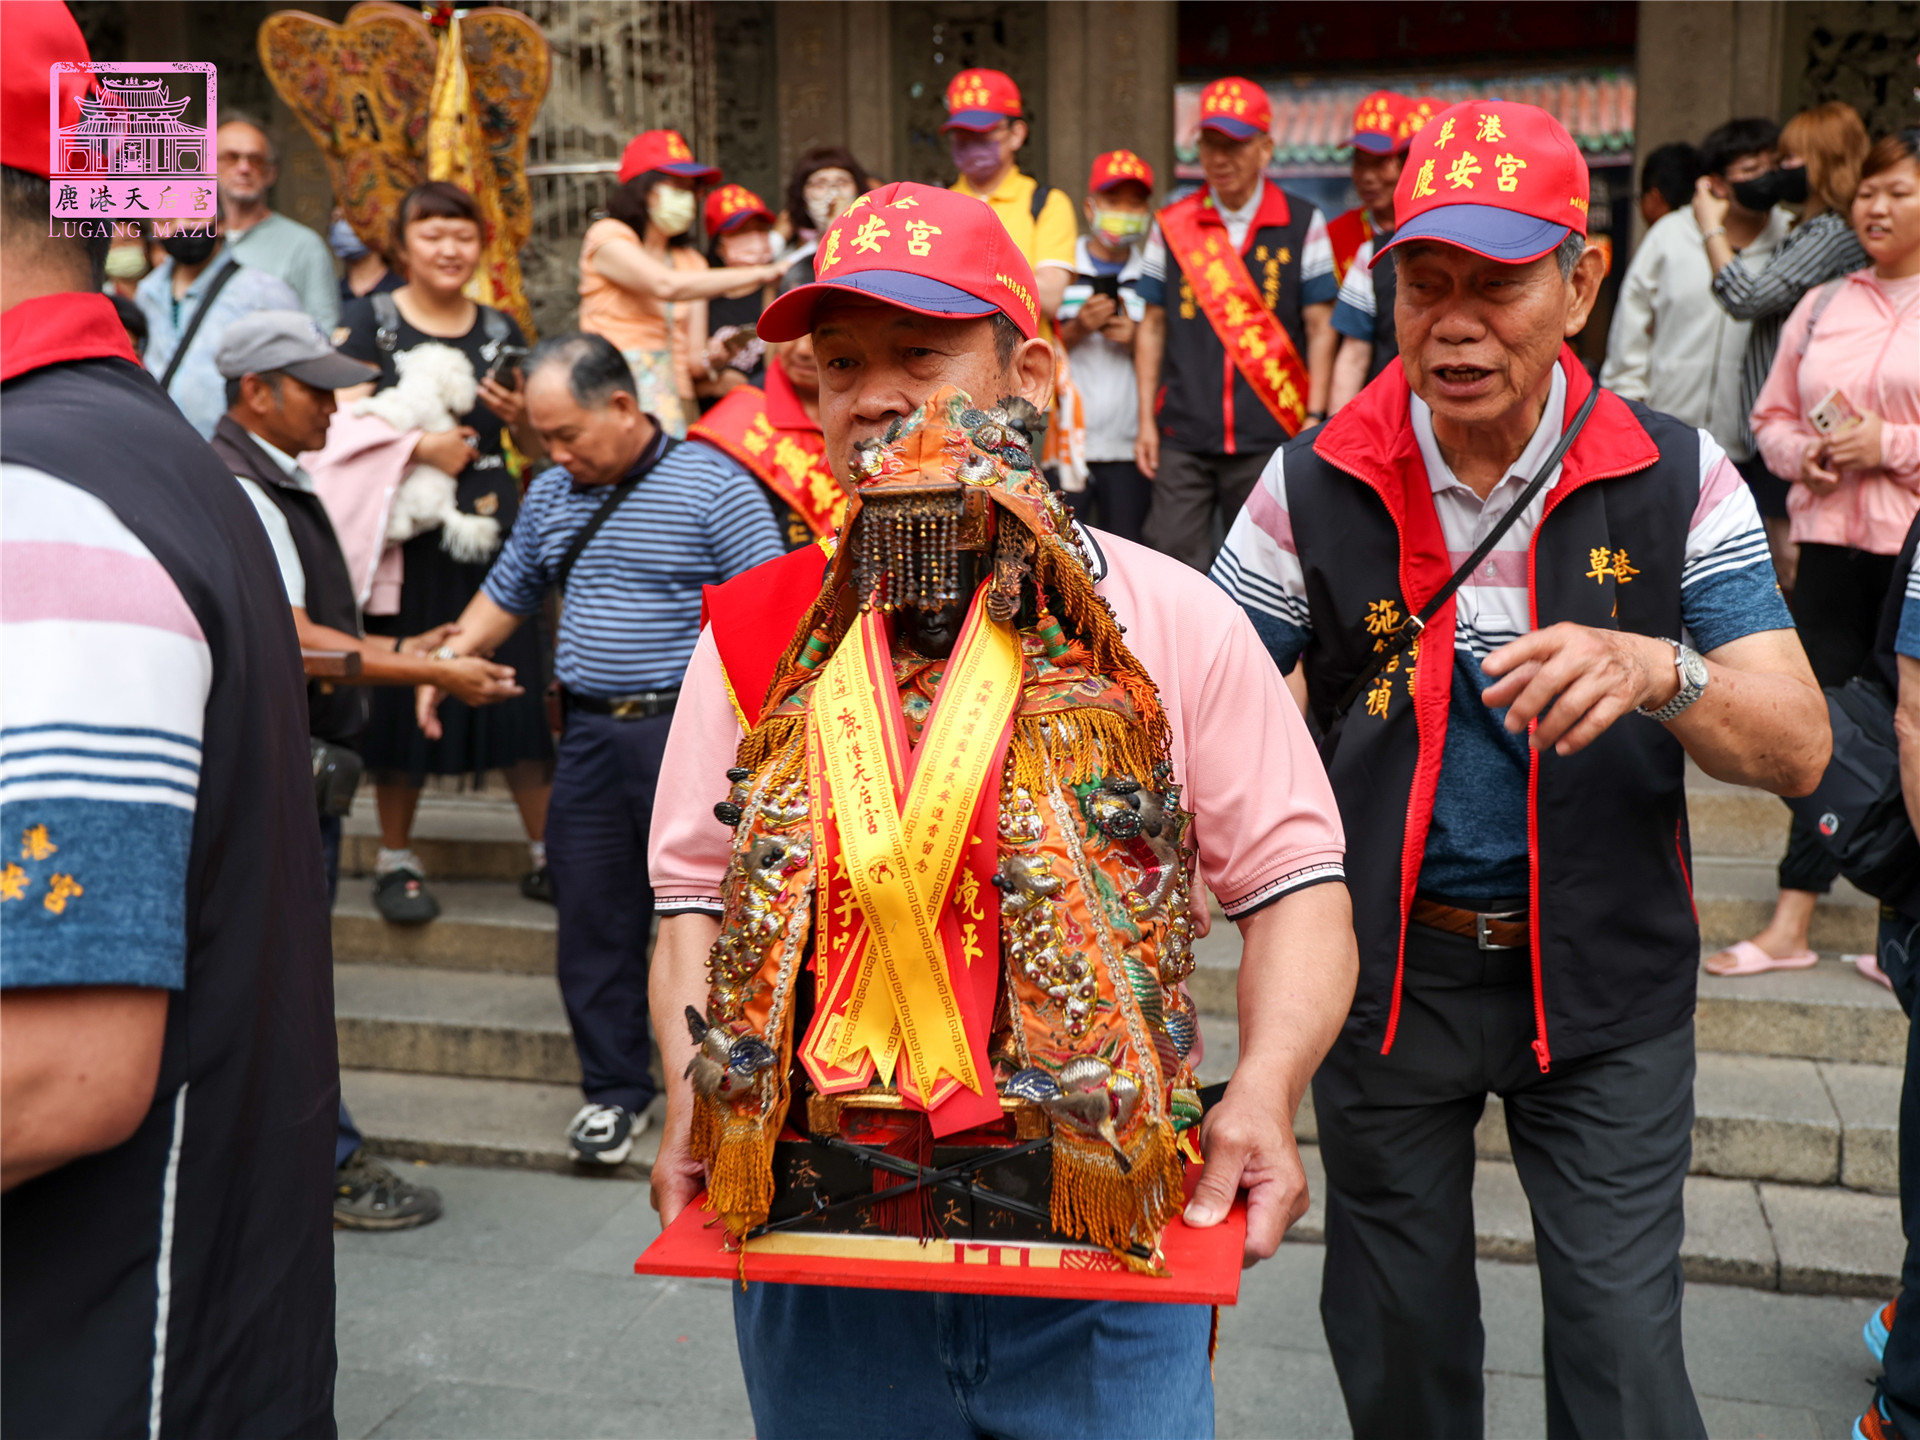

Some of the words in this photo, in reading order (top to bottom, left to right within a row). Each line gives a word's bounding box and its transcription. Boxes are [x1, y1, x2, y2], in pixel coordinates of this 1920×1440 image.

[1434, 114, 1506, 150] 草港
[1411, 151, 1527, 200] 慶安宮
[820, 213, 942, 276] 慶安宮
[836, 706, 881, 836] 鹿港天后宮
[913, 679, 994, 874] 風調雨順國泰民安進香留念
